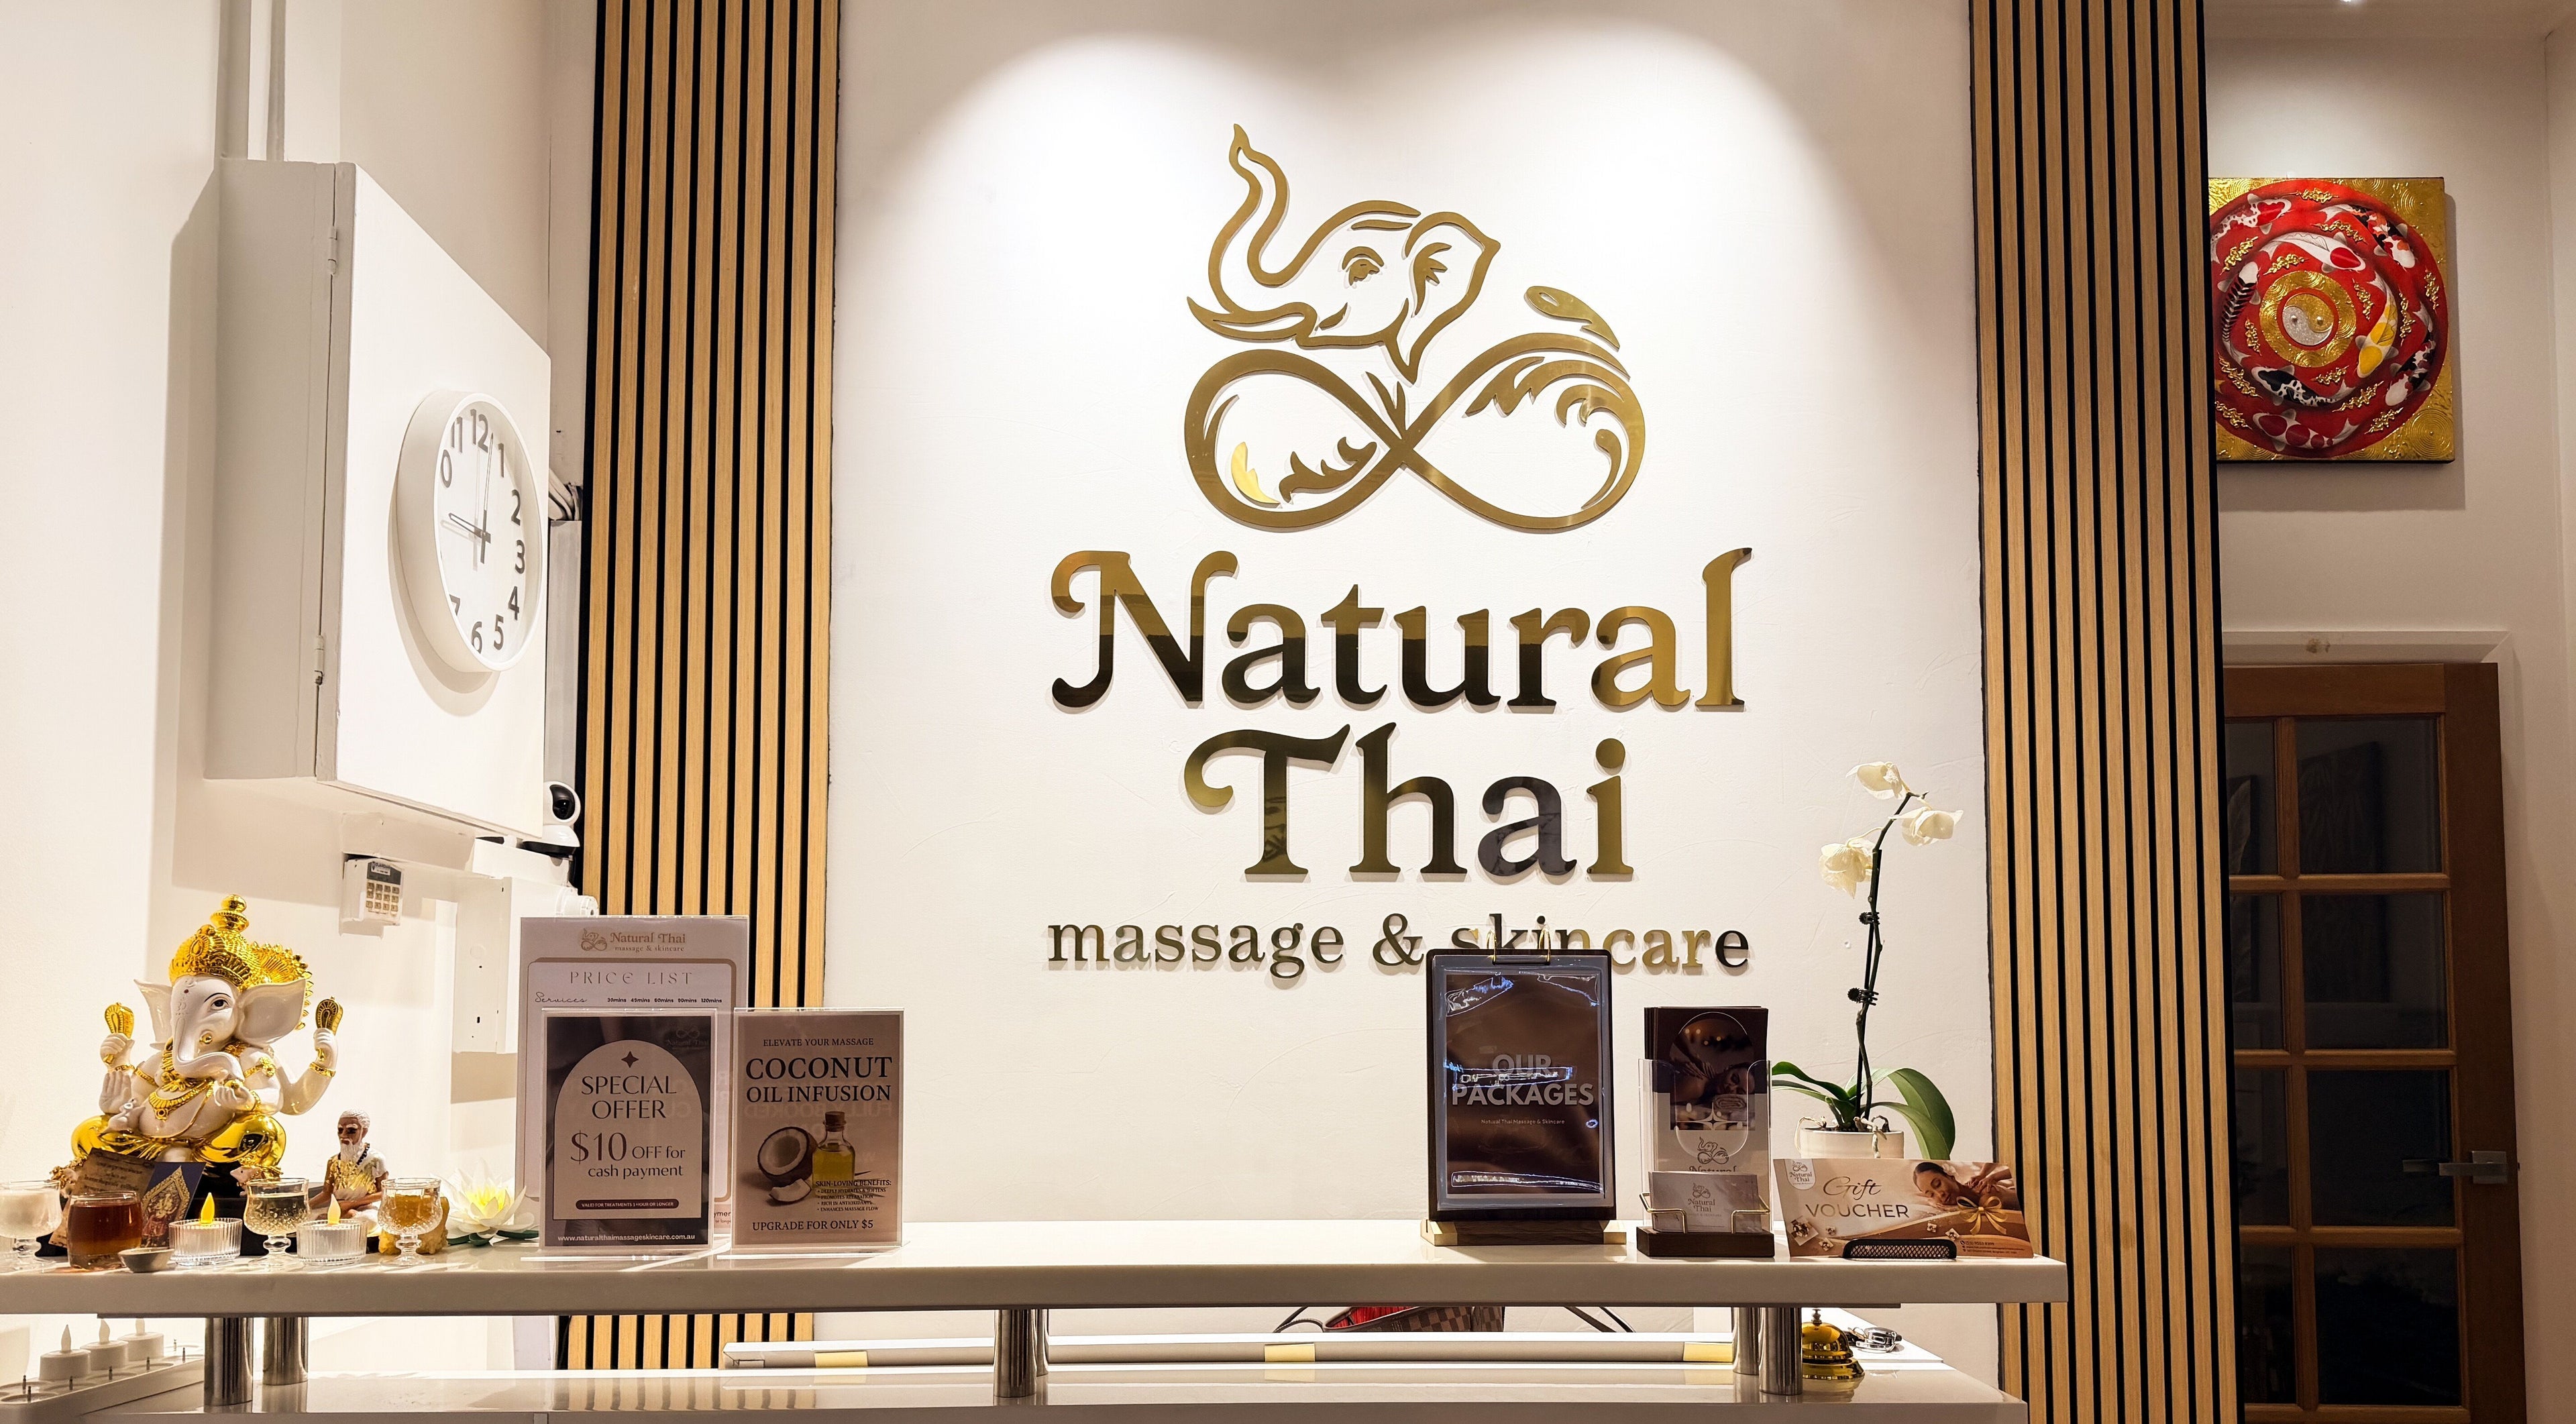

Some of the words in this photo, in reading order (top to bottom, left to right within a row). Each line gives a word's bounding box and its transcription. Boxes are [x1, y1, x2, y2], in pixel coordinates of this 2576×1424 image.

[451, 416, 463, 453] 11
[470, 408, 488, 453] 12
[440, 449, 453, 488] 0
[497, 443, 505, 478] 1
[511, 489, 521, 526] 2
[515, 539, 525, 574] 3
[508, 586, 520, 620] 4
[471, 621, 482, 654] 6
[494, 614, 504, 650] 5
[1051, 547, 1753, 708] Natural
[1183, 722, 1634, 876] Thai
[610, 932, 654, 943] Natural
[658, 932, 686, 943] Thai
[1047, 921, 1344, 979] massage
[1373, 913, 1427, 967] &
[1451, 913, 1750, 968] skincare
[570, 971, 634, 985] PRICE
[647, 971, 692, 985] LIST
[535, 991, 588, 1003] Services
[832, 1038, 874, 1046] MASSAGE
[746, 1056, 893, 1080] COCONUT
[1492, 1054, 1552, 1075] OUR
[581, 1075, 677, 1095] SPECIAL
[746, 1086, 783, 1103] OIL
[787, 1085, 892, 1102] INFUSION
[1452, 1083, 1595, 1105] PACKAGES
[592, 1099, 666, 1119] OFFER
[570, 1130, 627, 1165] $10
[632, 1146, 662, 1159] OFF
[665, 1146, 686, 1159] for
[588, 1164, 619, 1177] cash
[623, 1165, 684, 1180] payment
[1823, 1176, 1882, 1200] Gift
[1805, 1204, 1910, 1218] VOUCHER
[753, 1221, 804, 1231] UPGRADE
[806, 1221, 827, 1229] FOR
[830, 1220, 859, 1229] ONLY
[861, 1219, 873, 1229] $5
[557, 1234, 696, 1242] www.naturalthaimassageskincare.com.au
